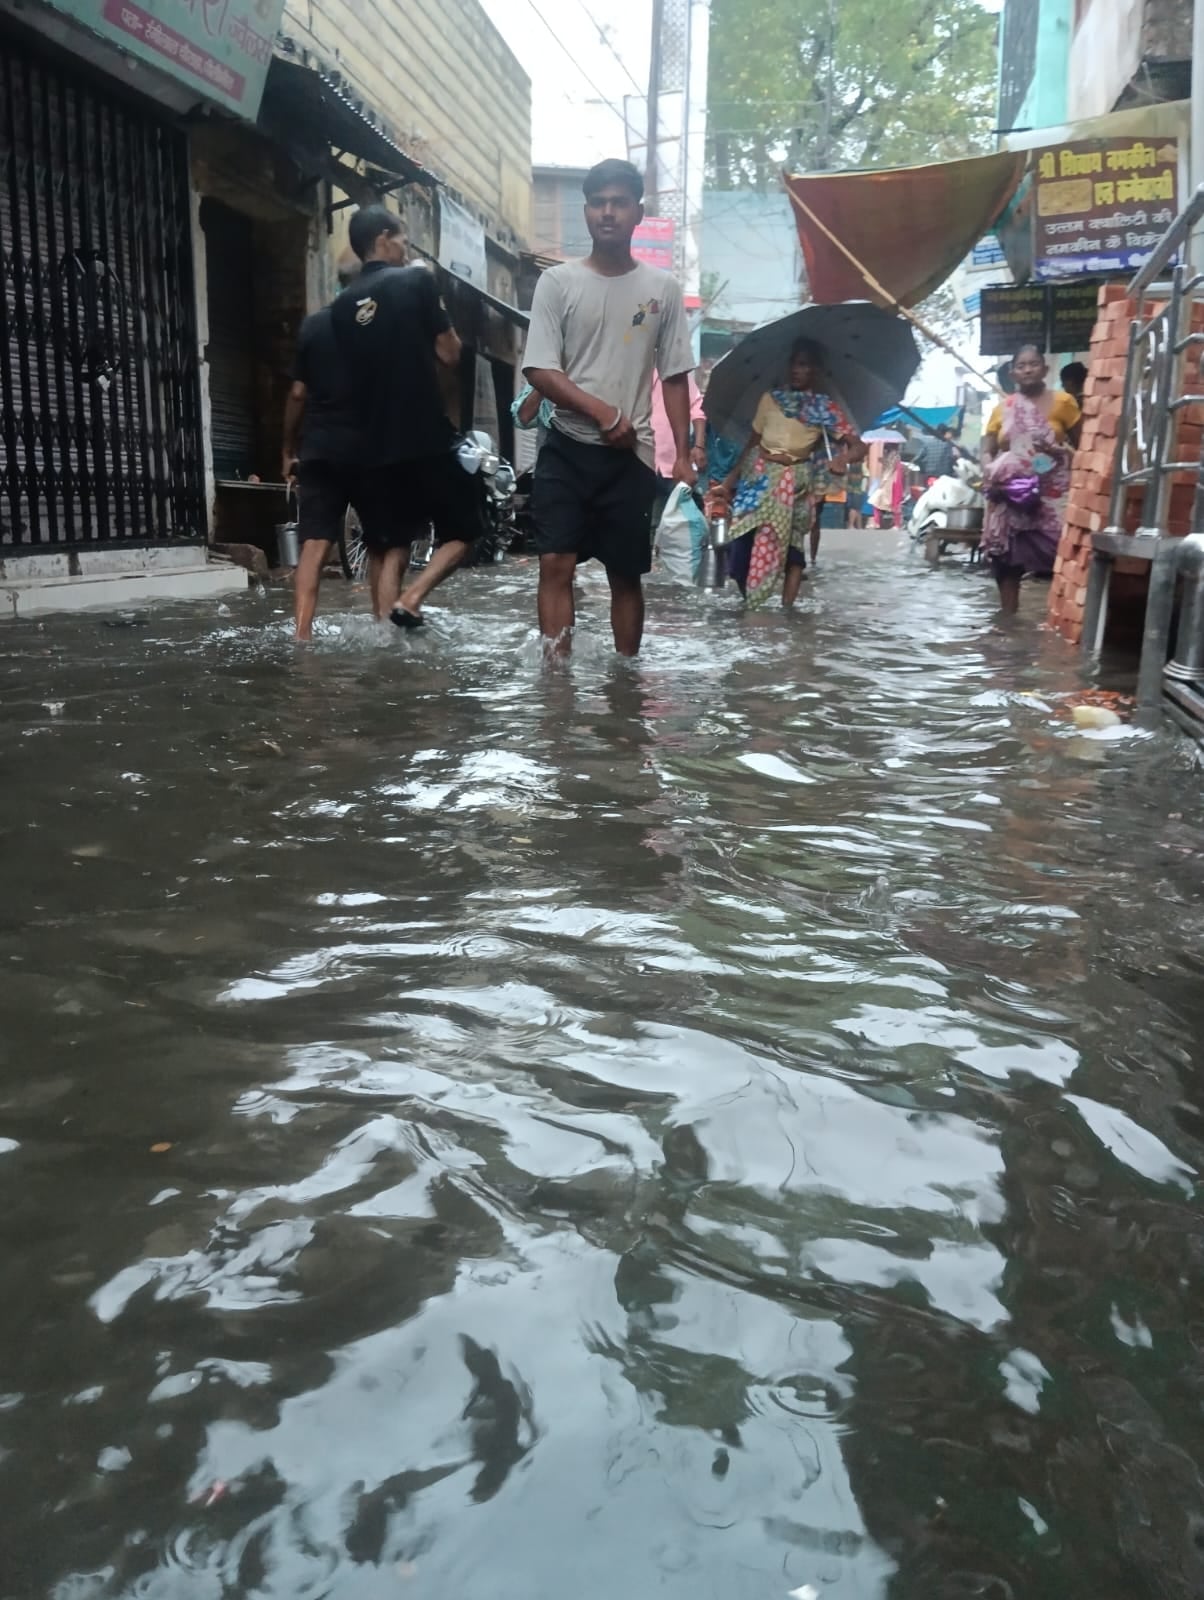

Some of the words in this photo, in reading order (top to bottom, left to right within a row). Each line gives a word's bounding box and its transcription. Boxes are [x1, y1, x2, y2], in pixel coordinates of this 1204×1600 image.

[1044, 220, 1084, 235] उत्तम
[1088, 209, 1148, 230] क्वालिटी
[1152, 207, 1172, 224] की
[1045, 236, 1101, 255] नमकीन
[1104, 234, 1122, 249] के
